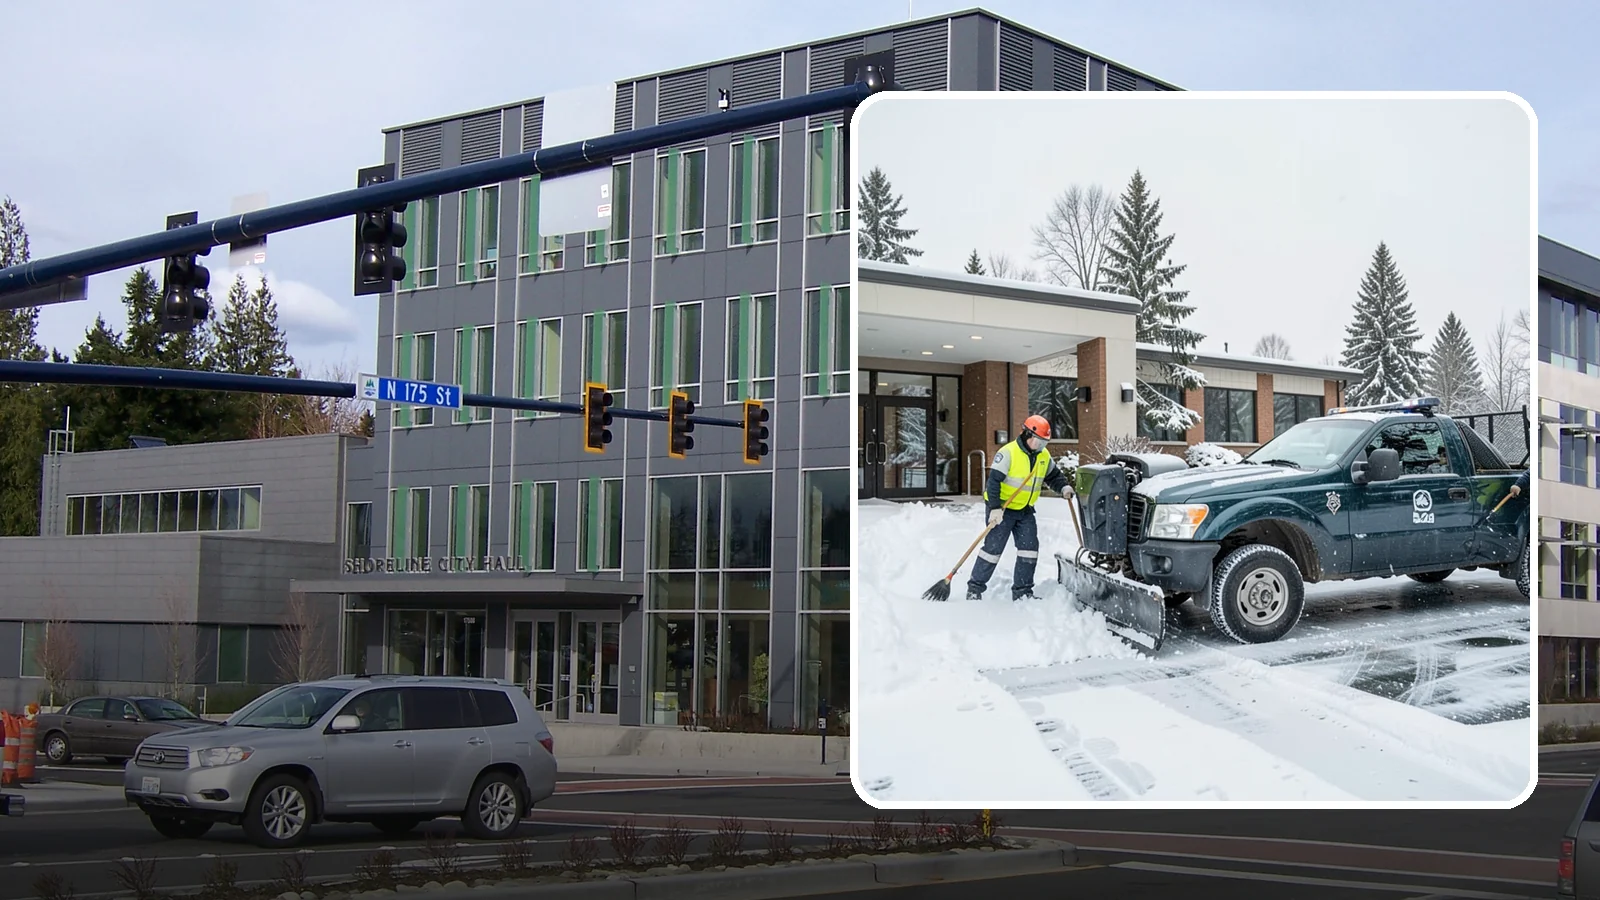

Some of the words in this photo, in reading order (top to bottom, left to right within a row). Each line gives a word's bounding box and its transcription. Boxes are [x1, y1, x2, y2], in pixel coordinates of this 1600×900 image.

[387, 380, 396, 400] N
[405, 382, 427, 403] 175
[436, 386, 451, 406] St
[343, 557, 431, 573] SHORELINE
[438, 556, 475, 572] CITY
[483, 556, 526, 572] HALL
